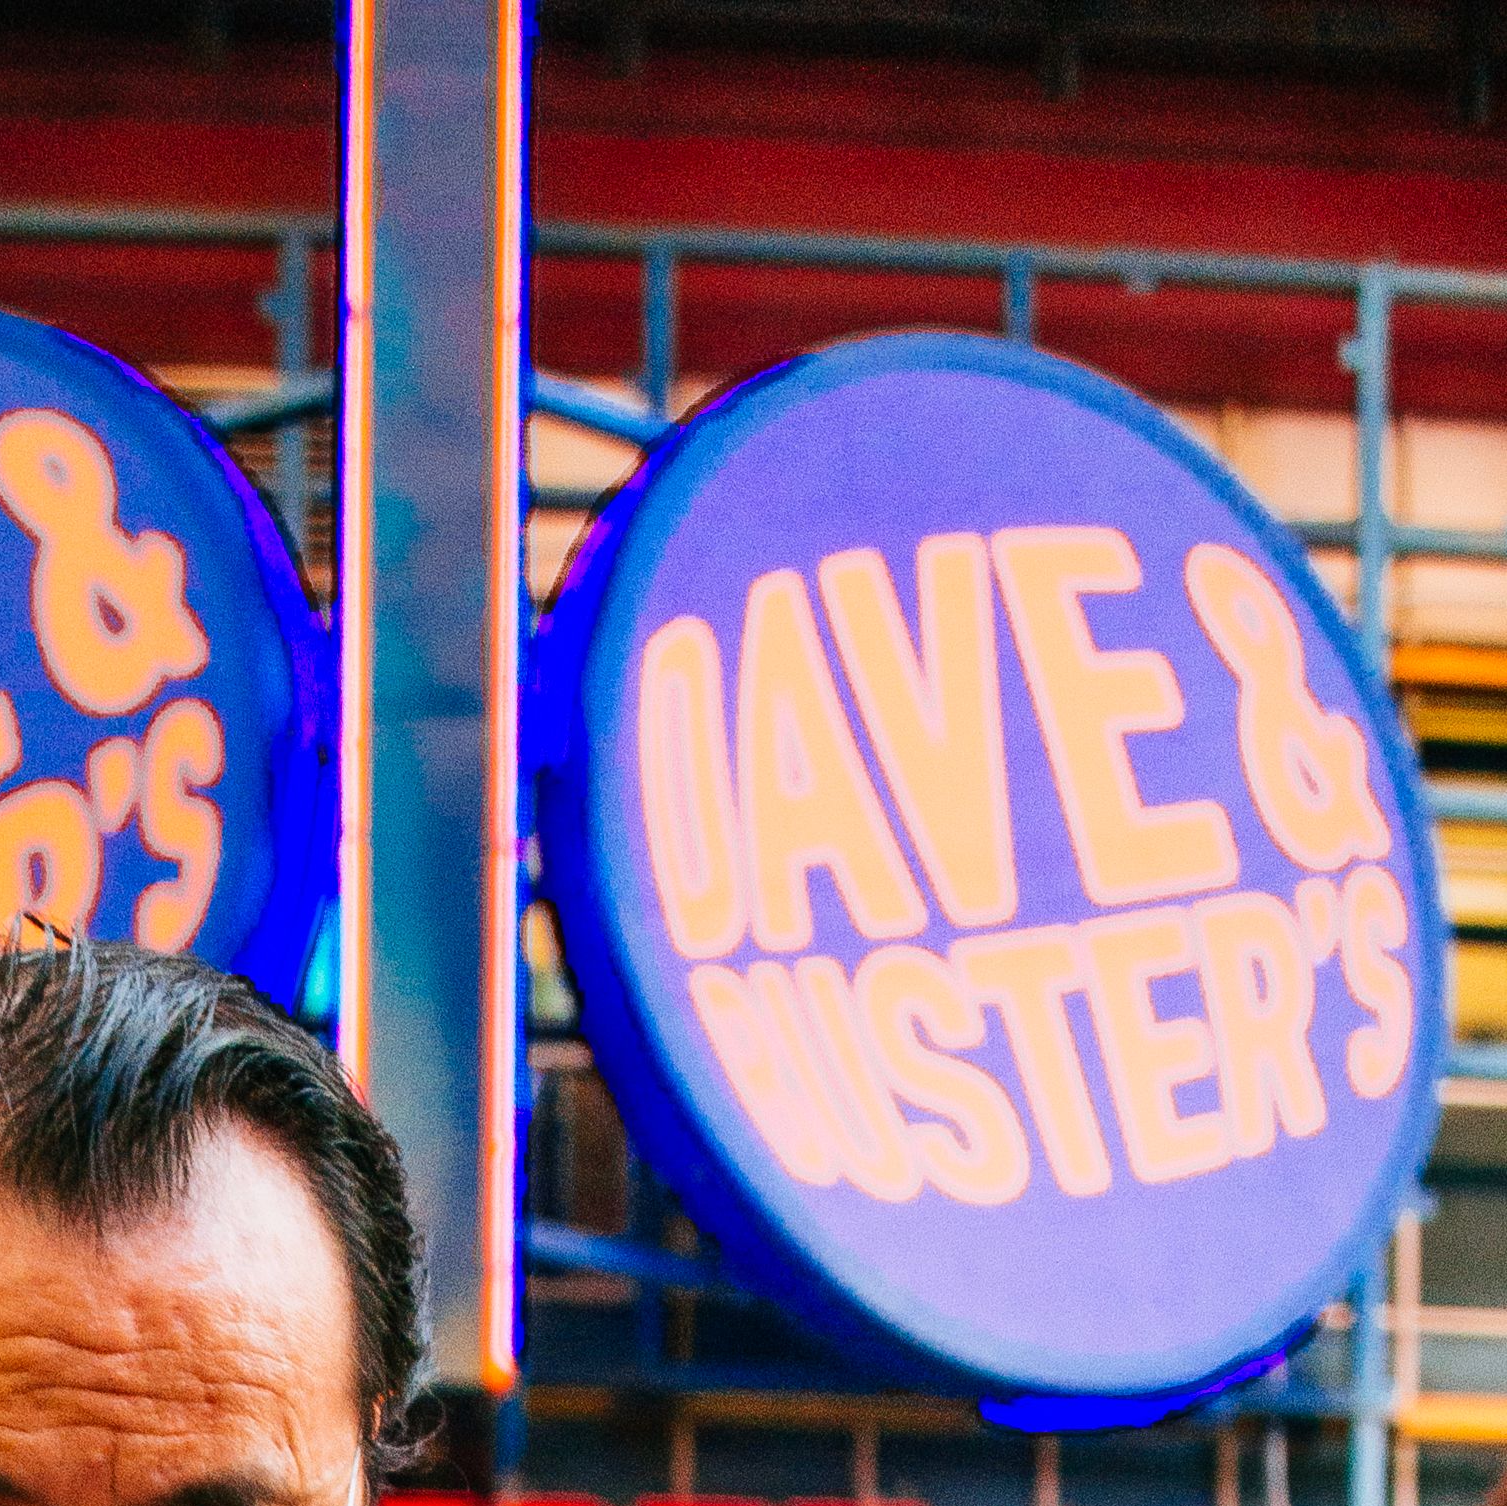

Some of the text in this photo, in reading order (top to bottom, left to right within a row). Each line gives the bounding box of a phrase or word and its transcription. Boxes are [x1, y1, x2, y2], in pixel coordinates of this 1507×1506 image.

[639, 525, 1390, 959] DAVE &
[690, 867, 1415, 1206] BUSTER'S
